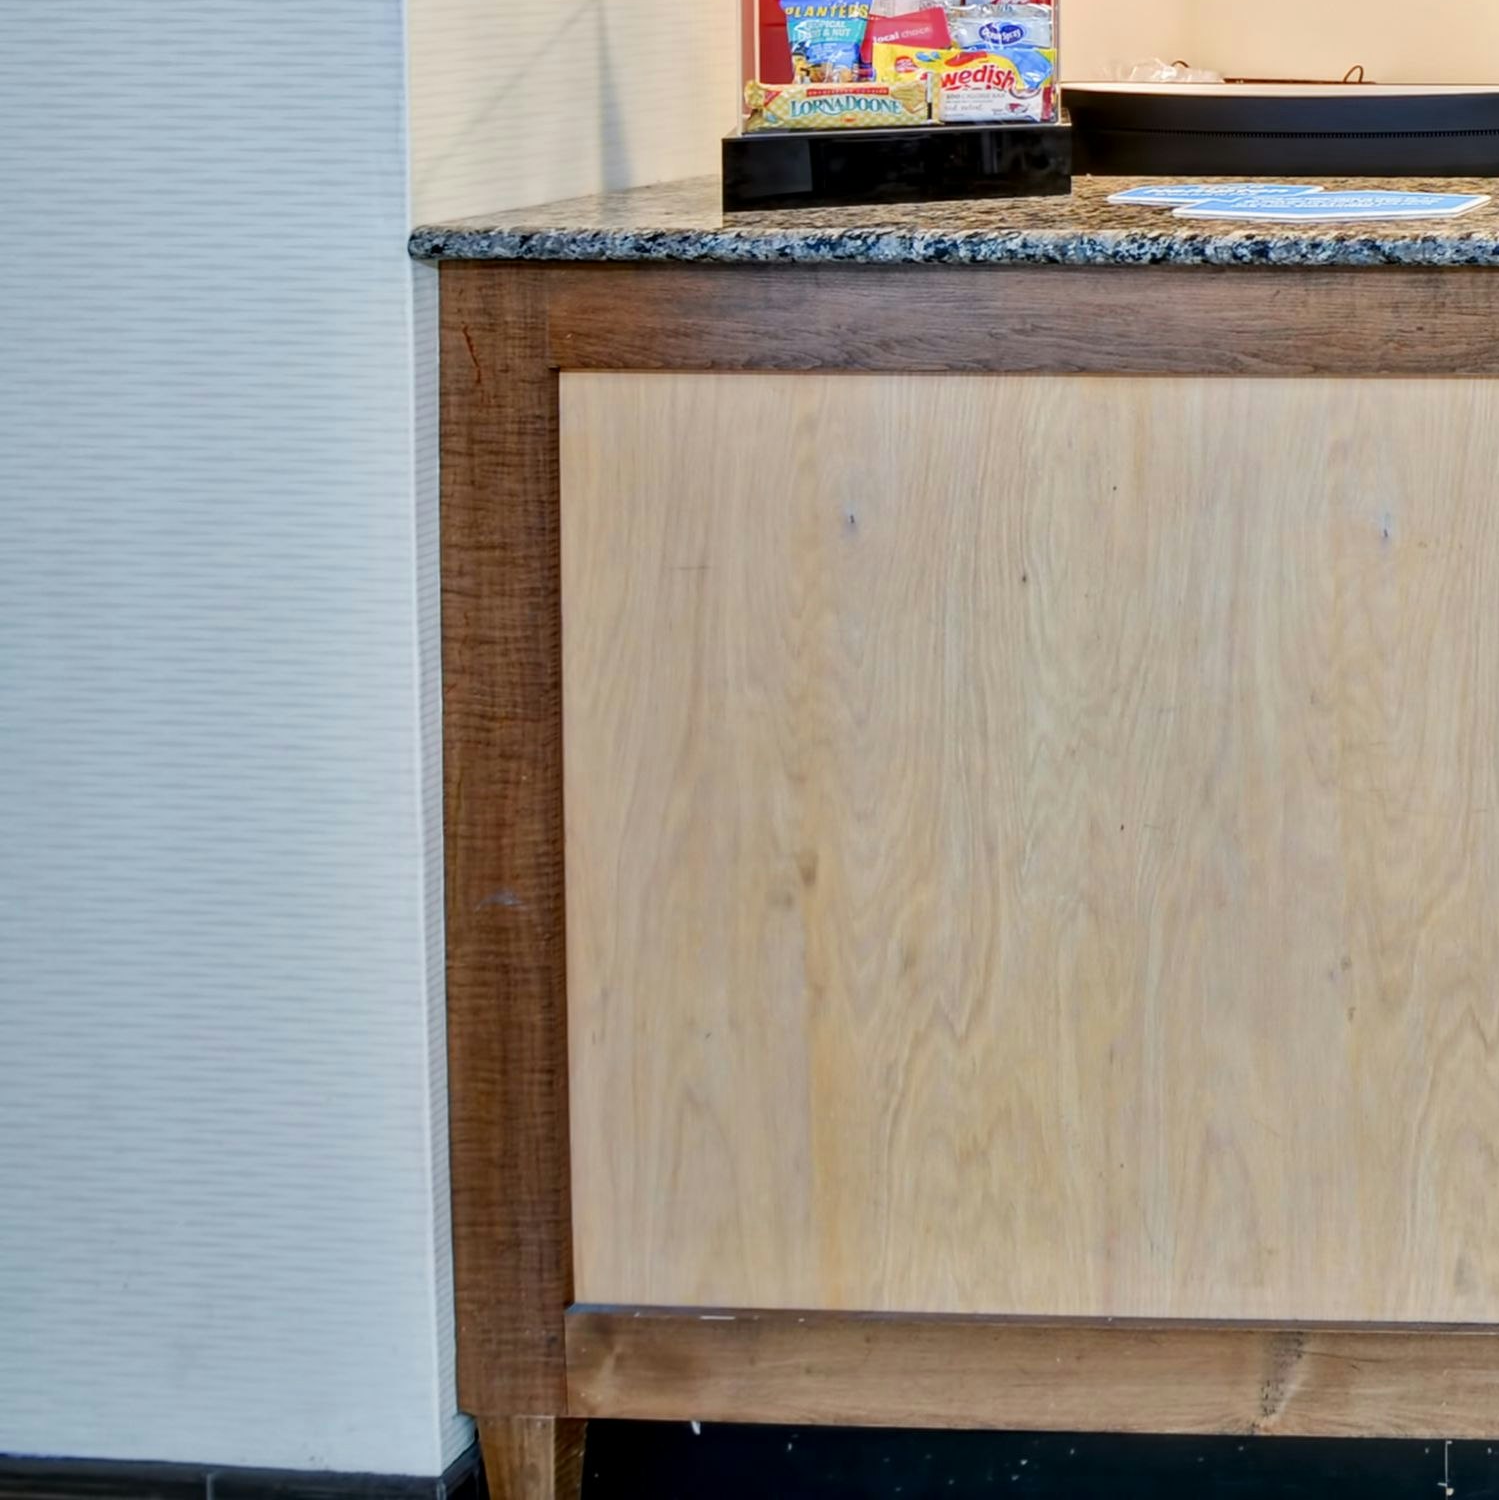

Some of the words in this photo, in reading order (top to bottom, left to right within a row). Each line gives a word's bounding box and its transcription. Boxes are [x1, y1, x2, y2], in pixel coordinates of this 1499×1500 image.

[785, 3, 869, 19] PLANTERS
[872, 31, 900, 43] local
[921, 65, 1015, 91] wedish
[791, 98, 845, 117] LORNA
[846, 95, 901, 115] DOONE
